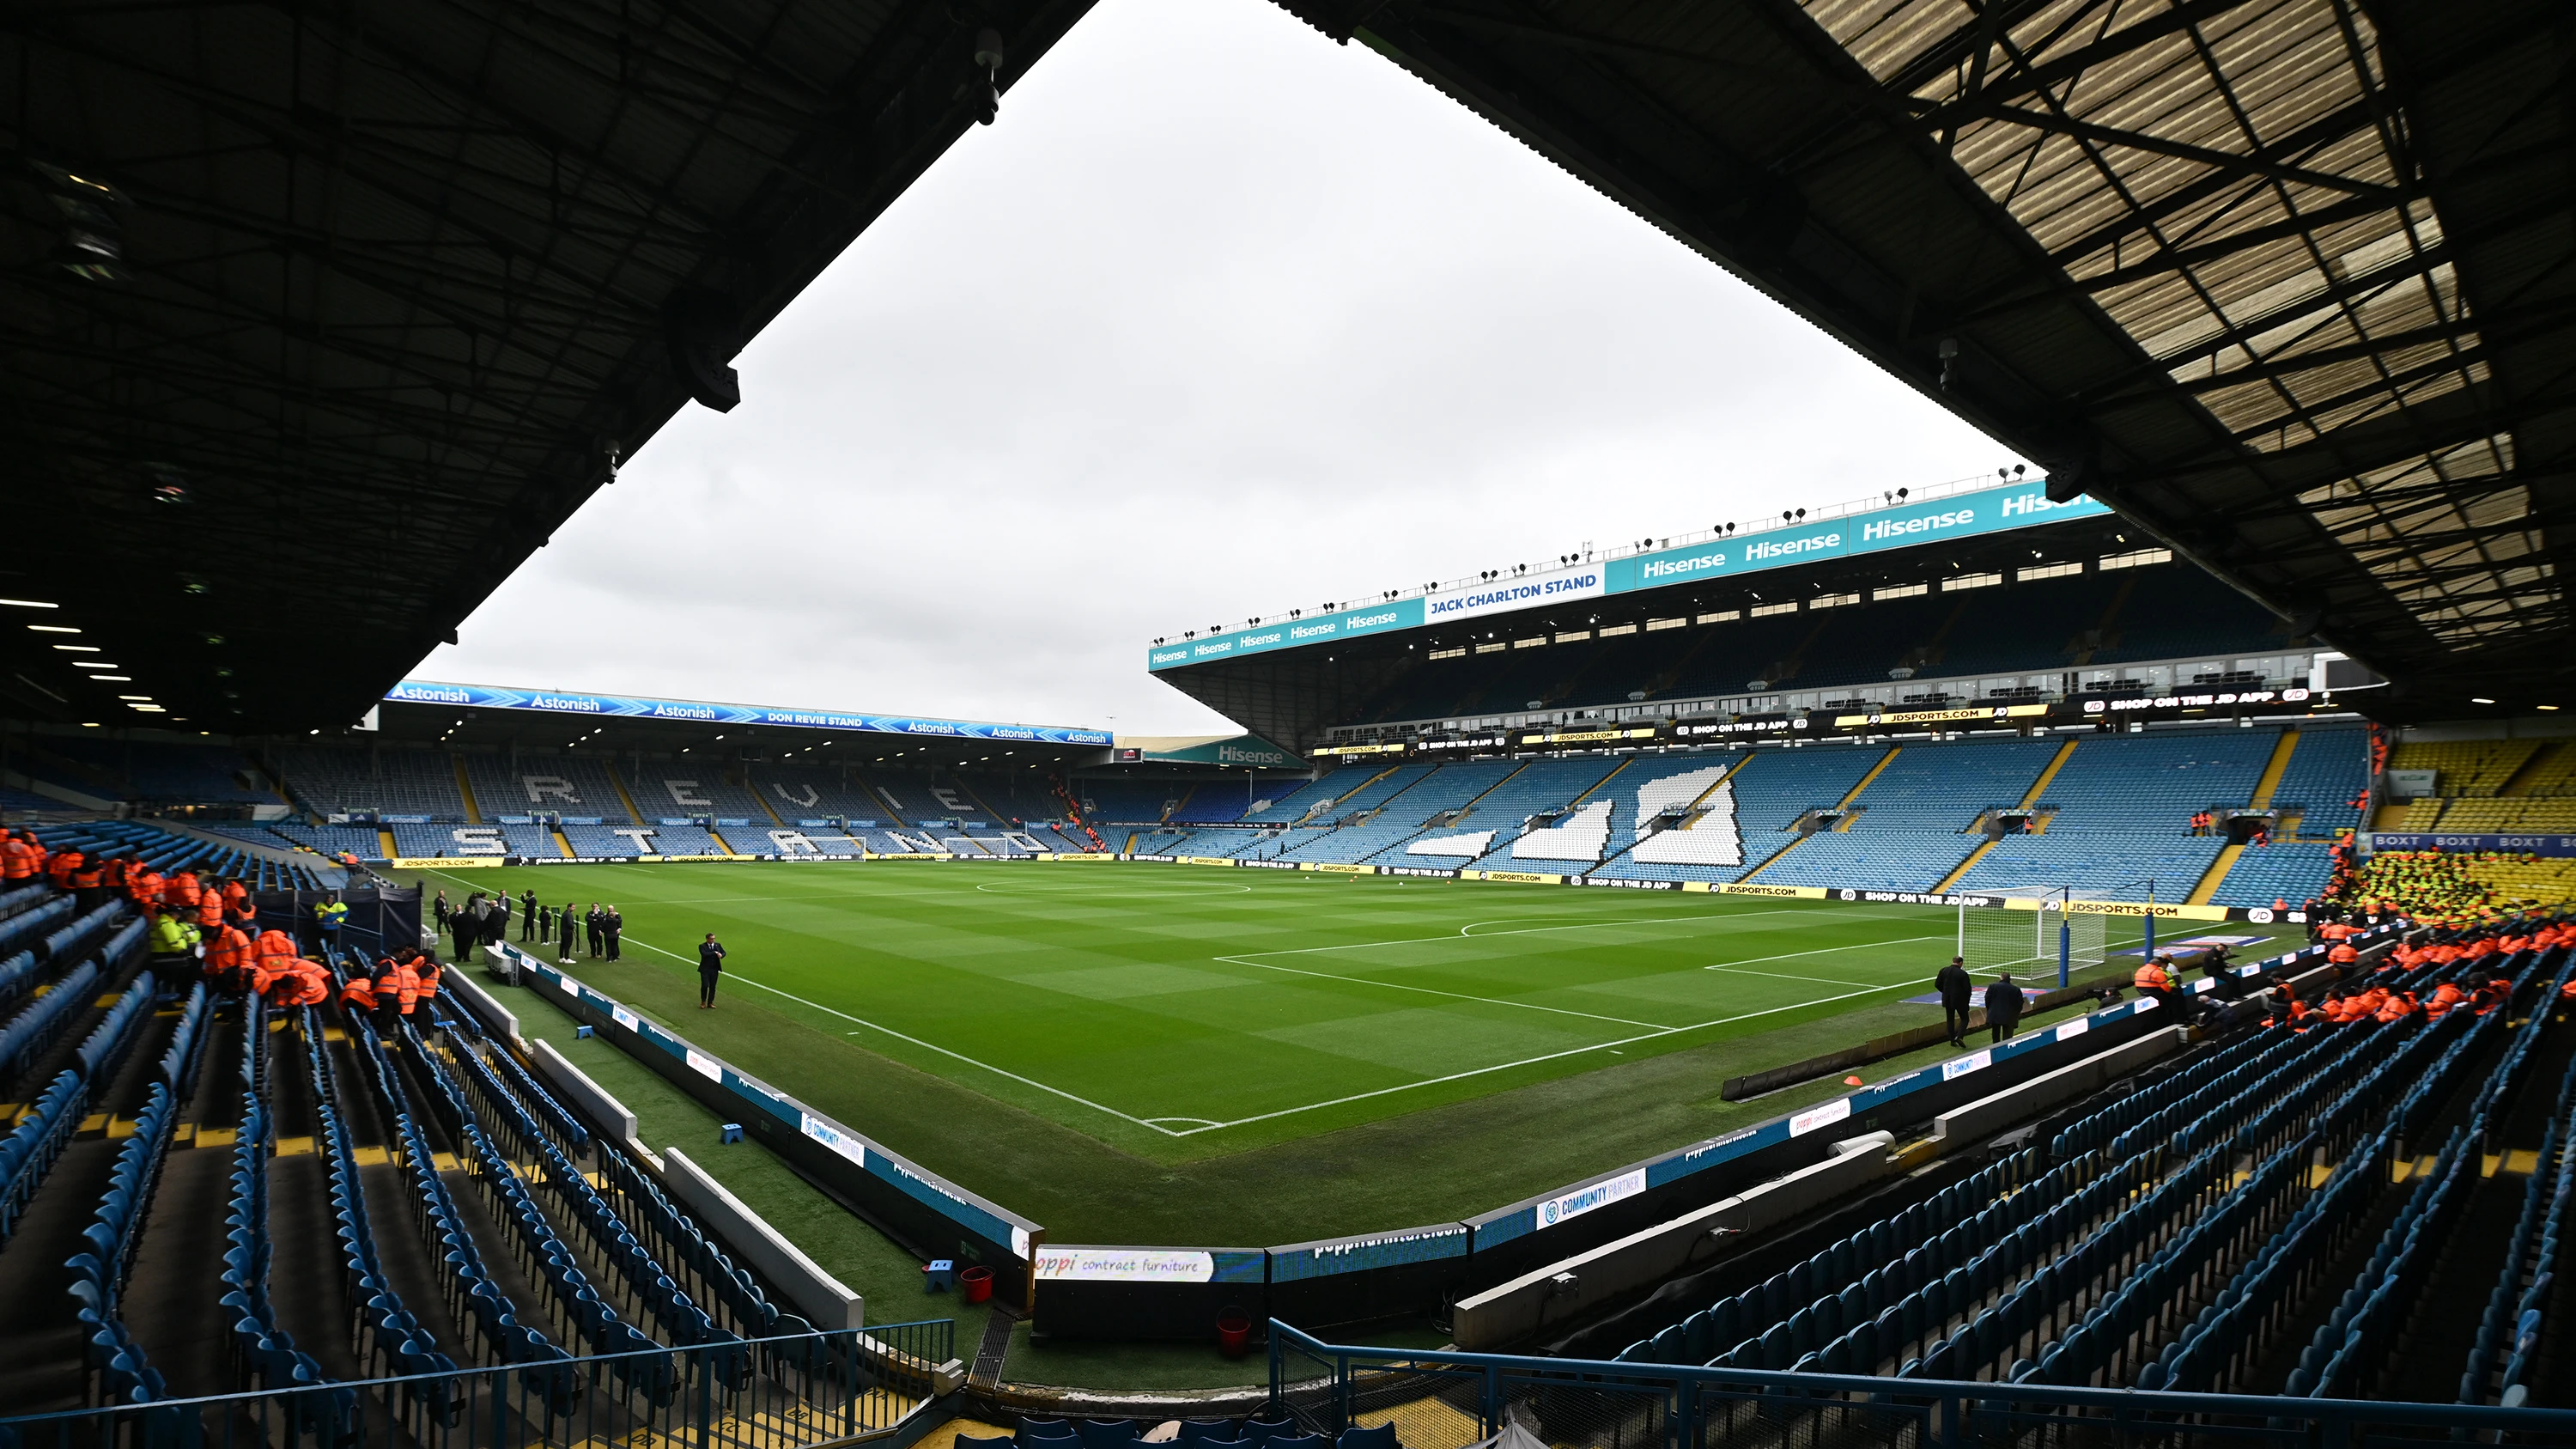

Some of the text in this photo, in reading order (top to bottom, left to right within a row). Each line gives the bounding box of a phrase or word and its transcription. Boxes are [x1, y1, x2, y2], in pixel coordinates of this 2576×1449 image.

[1862, 509, 1974, 541] Hisense
[1746, 533, 1840, 562] Hisense
[1643, 553, 1726, 578] Hisense
[1431, 575, 1596, 614] JACK CHARLTON STAND
[1346, 612, 1397, 630] Hisense
[1291, 622, 1336, 639] Hisense
[1240, 631, 1281, 648] Hisense
[1152, 648, 1187, 664] Hisense
[1194, 641, 1231, 656] Hisense
[391, 685, 470, 703] Astonish
[2110, 699, 2152, 710] SHOP
[2154, 697, 2178, 708] ON
[2180, 695, 2214, 706] THE
[2215, 693, 2237, 704] JD
[2238, 691, 2275, 703] APP
[531, 694, 599, 712] Astonish
[654, 703, 715, 720] Astonish
[1891, 710, 1978, 721] JDSPORTS.COM
[768, 712, 862, 727] DON REVIE STAND
[908, 721, 954, 735] Astonish
[992, 727, 1034, 740] Astonish
[1692, 725, 1716, 734] SHOP
[1719, 724, 1732, 733] ON
[1734, 723, 1753, 732] THE
[1753, 722, 1766, 731] JD
[1768, 721, 1788, 729] APP
[1066, 732, 1106, 744] Astonish
[1558, 732, 1613, 740] JDSPORTS.COM
[1218, 746, 1283, 764] Hisense
[2375, 836, 2420, 846] BOXT
[2435, 837, 2482, 846] BOXT
[2499, 837, 2546, 847] BOXT
[1588, 878, 1609, 886] SHOP
[1624, 880, 1640, 888] THE
[1641, 880, 1652, 889] JD
[1653, 881, 1671, 890] APP
[1725, 886, 1796, 896] JDSPORTS.COM
[1865, 892, 1896, 902] SHOP
[1899, 893, 1917, 903] ON
[1918, 894, 1943, 904] THE
[1943, 895, 1960, 905] JD
[1963, 897, 1989, 907] APP
[2069, 903, 2178, 916] JDSPORTS.COM
[1562, 1176, 1639, 1215] COMMUNITY PARTNER
[1036, 1254, 1199, 1276] oppi contract furniture
